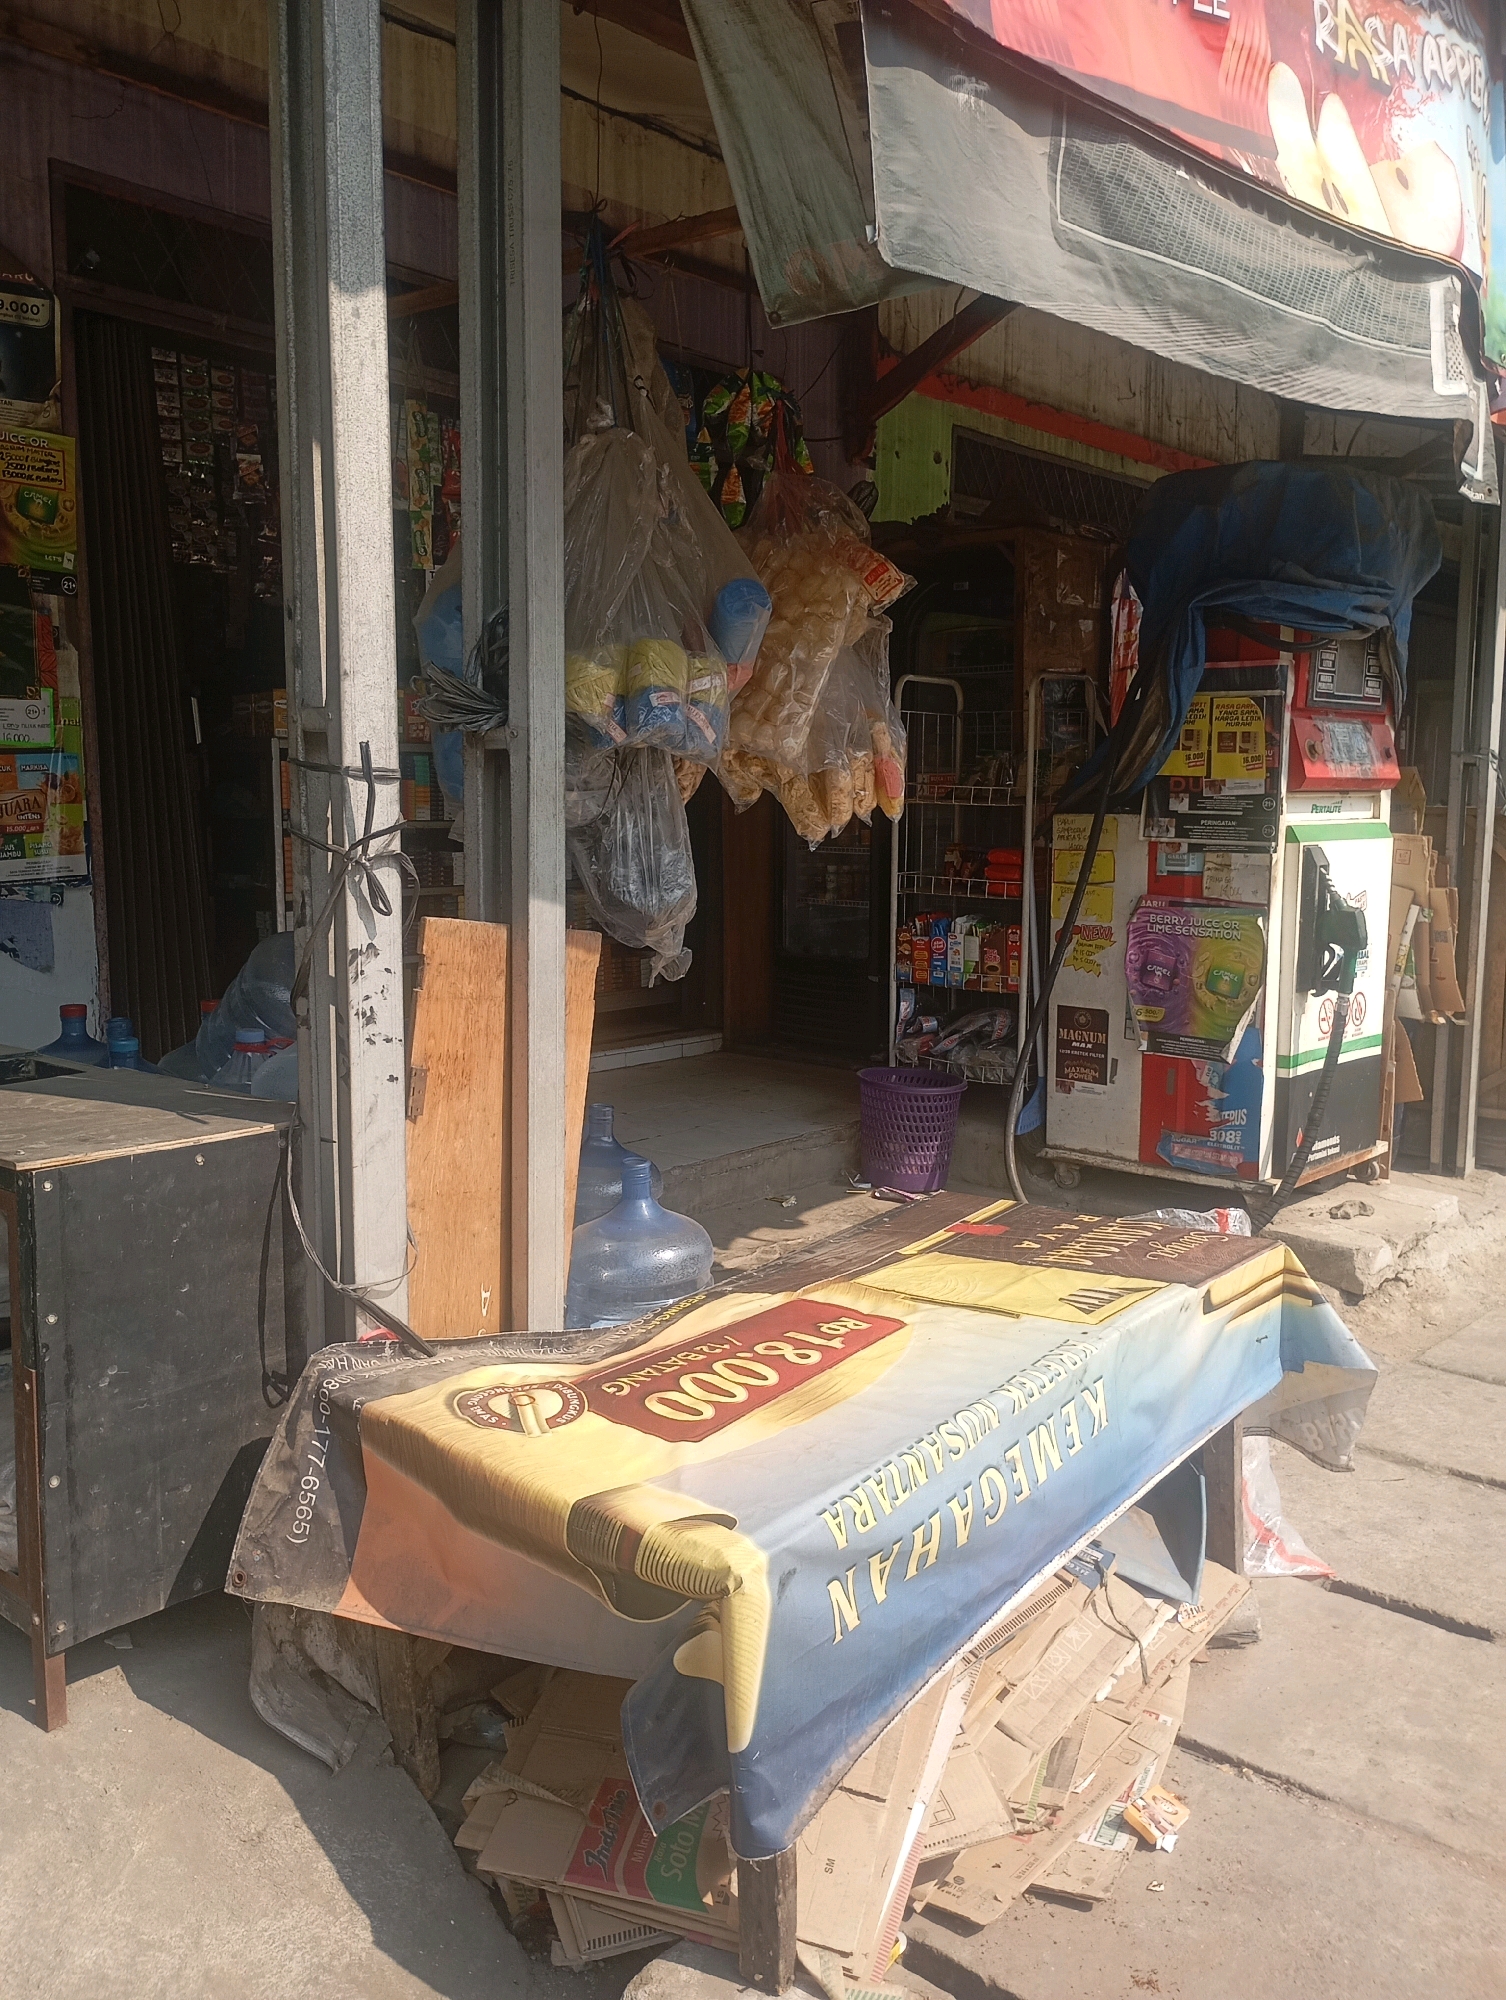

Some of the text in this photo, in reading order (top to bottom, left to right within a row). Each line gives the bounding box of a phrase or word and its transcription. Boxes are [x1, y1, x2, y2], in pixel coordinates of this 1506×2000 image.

[1311, 803, 1343, 813] PERTALITE
[1149, 914, 1240, 929] BERRY JUICE OR
[1081, 924, 1113, 941] NEW
[1147, 924, 1241, 940] LIME SENSATION
[1147, 964, 1171, 977] CAMEL
[1213, 969, 1239, 982] CAMEL
[1059, 1028, 1107, 1044] MAGNUM
[1071, 1041, 1093, 1049] MAX
[1064, 1066, 1099, 1078] MAXIMUM
[1068, 1072, 1093, 1081] POWER
[1209, 1130, 1236, 1144] 308
[1032, 1214, 1172, 1267] USANTARA
[1146, 1230, 1230, 1263] Surya
[601, 1349, 707, 1396] BATANG
[644, 1317, 874, 1422] Rp 18.000
[552, 1383, 581, 1424] DIBUNGKUS
[469, 1404, 499, 1424] EMAS
[816, 1339, 1099, 1550] KRETEK NUSANTARA
[826, 1375, 1109, 1646] KEMEGAHAN
[653, 1841, 667, 1863] Rasa
[660, 1830, 695, 1882] Soto
[824, 1858, 836, 1875] SM
